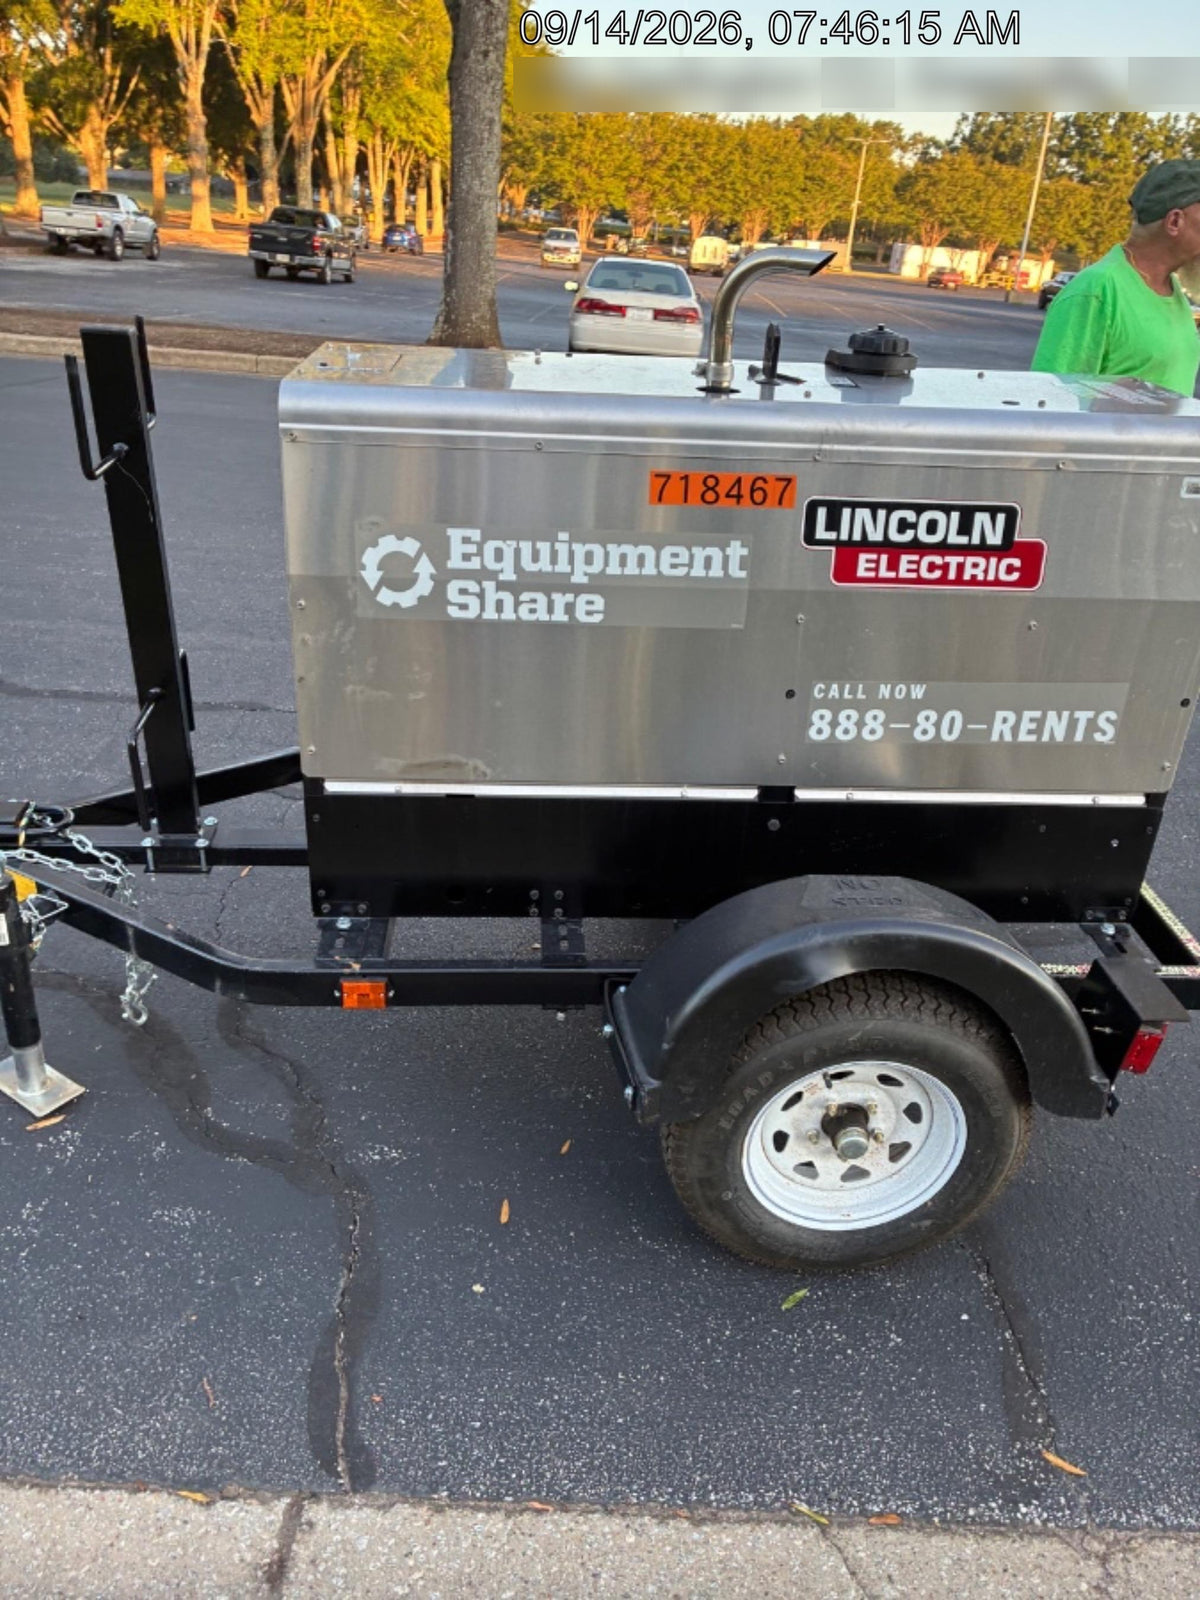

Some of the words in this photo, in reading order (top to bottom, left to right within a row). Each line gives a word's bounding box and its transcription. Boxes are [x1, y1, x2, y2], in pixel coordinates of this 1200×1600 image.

[654, 473, 793, 506] 718467
[814, 506, 1006, 546] LINCOLN
[446, 528, 749, 583] Equipment
[856, 552, 1022, 582] ELECTRIC
[446, 579, 606, 623] Share
[813, 683, 867, 700] CALL
[878, 683, 927, 700] NOW
